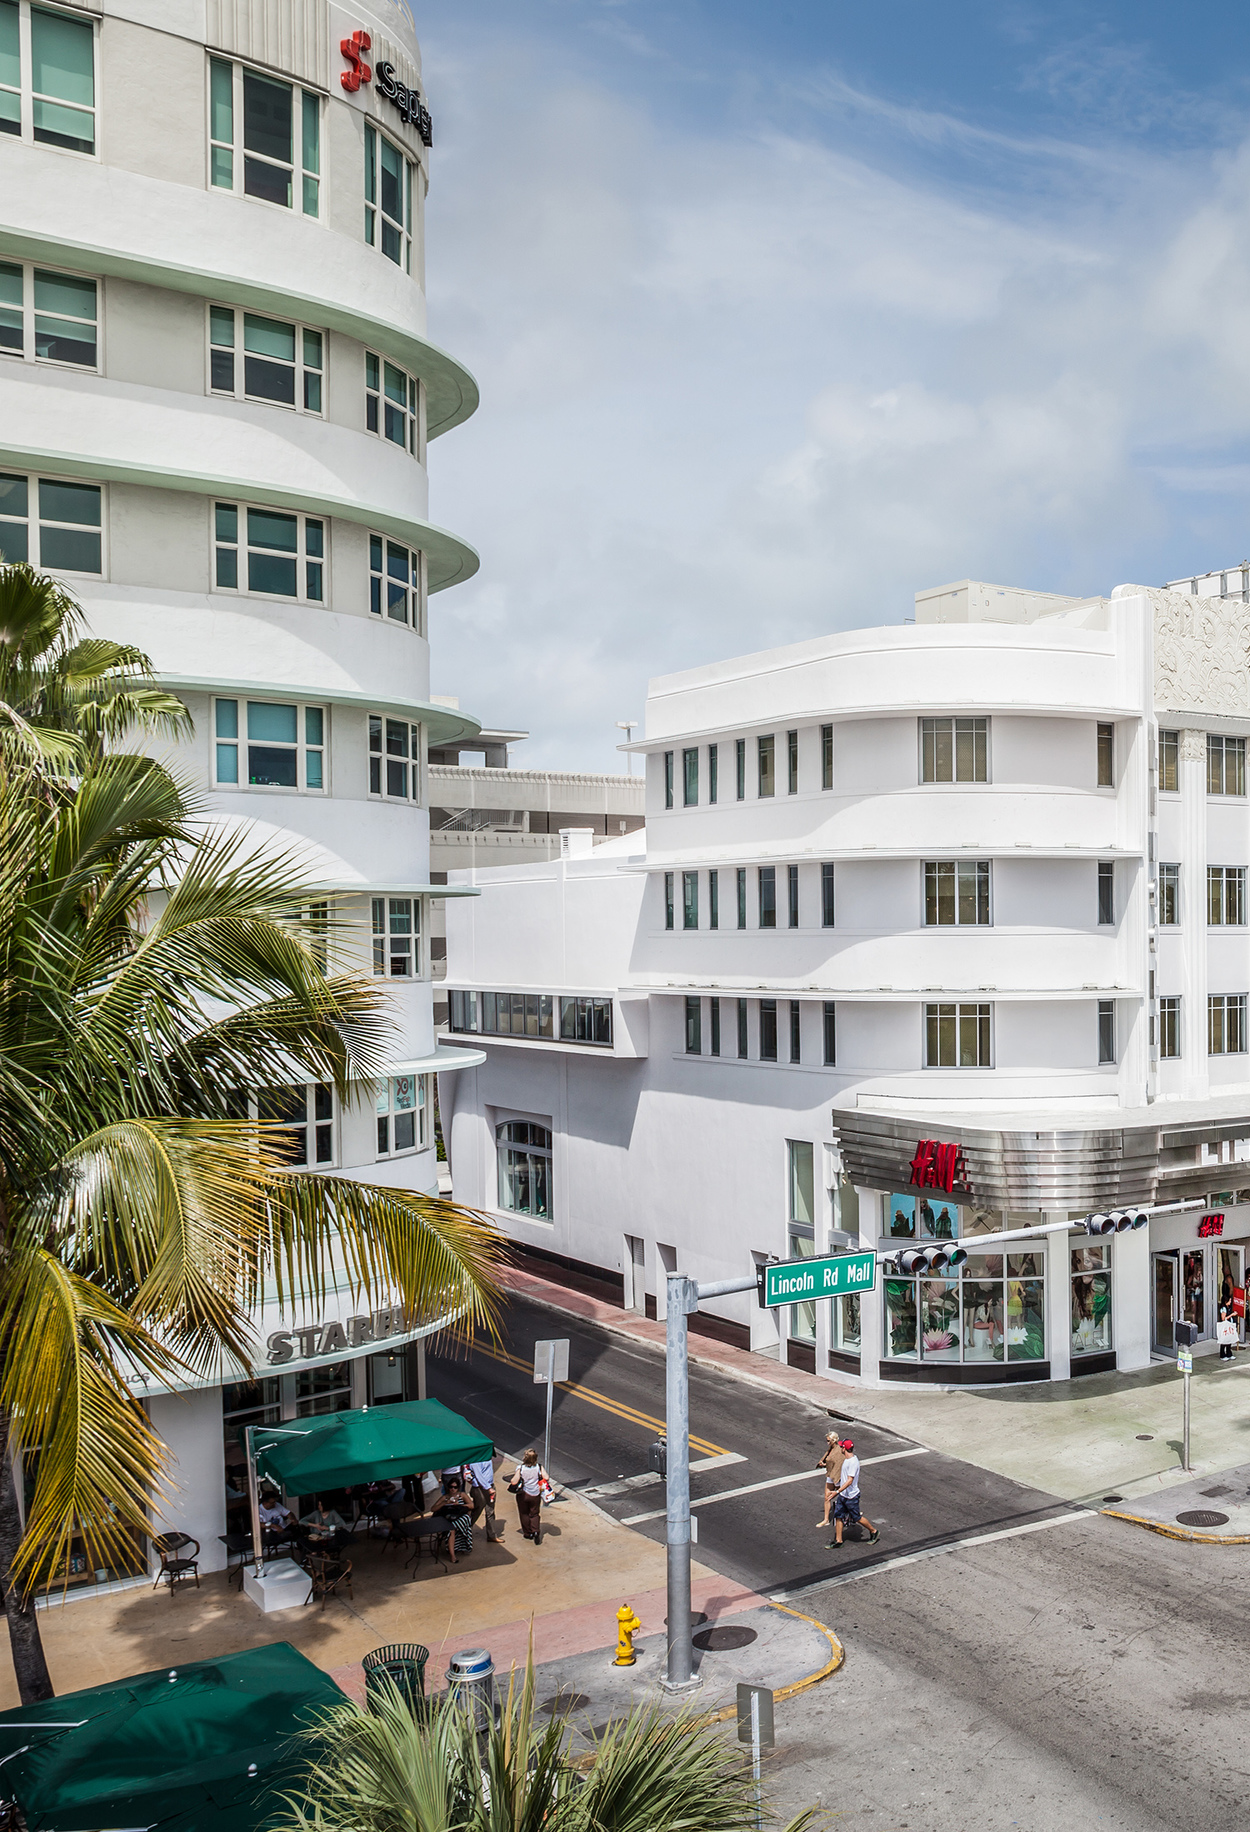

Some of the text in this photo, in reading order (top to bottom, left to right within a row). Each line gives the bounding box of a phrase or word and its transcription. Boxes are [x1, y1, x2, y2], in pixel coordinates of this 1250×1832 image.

[908, 1138, 962, 1194] H&M
[1198, 1213, 1225, 1239] H&M
[771, 1262, 871, 1296] Lincoln Rd Mall
[266, 1306, 408, 1365] STARB
[1072, 1330, 1102, 1348] ALE
